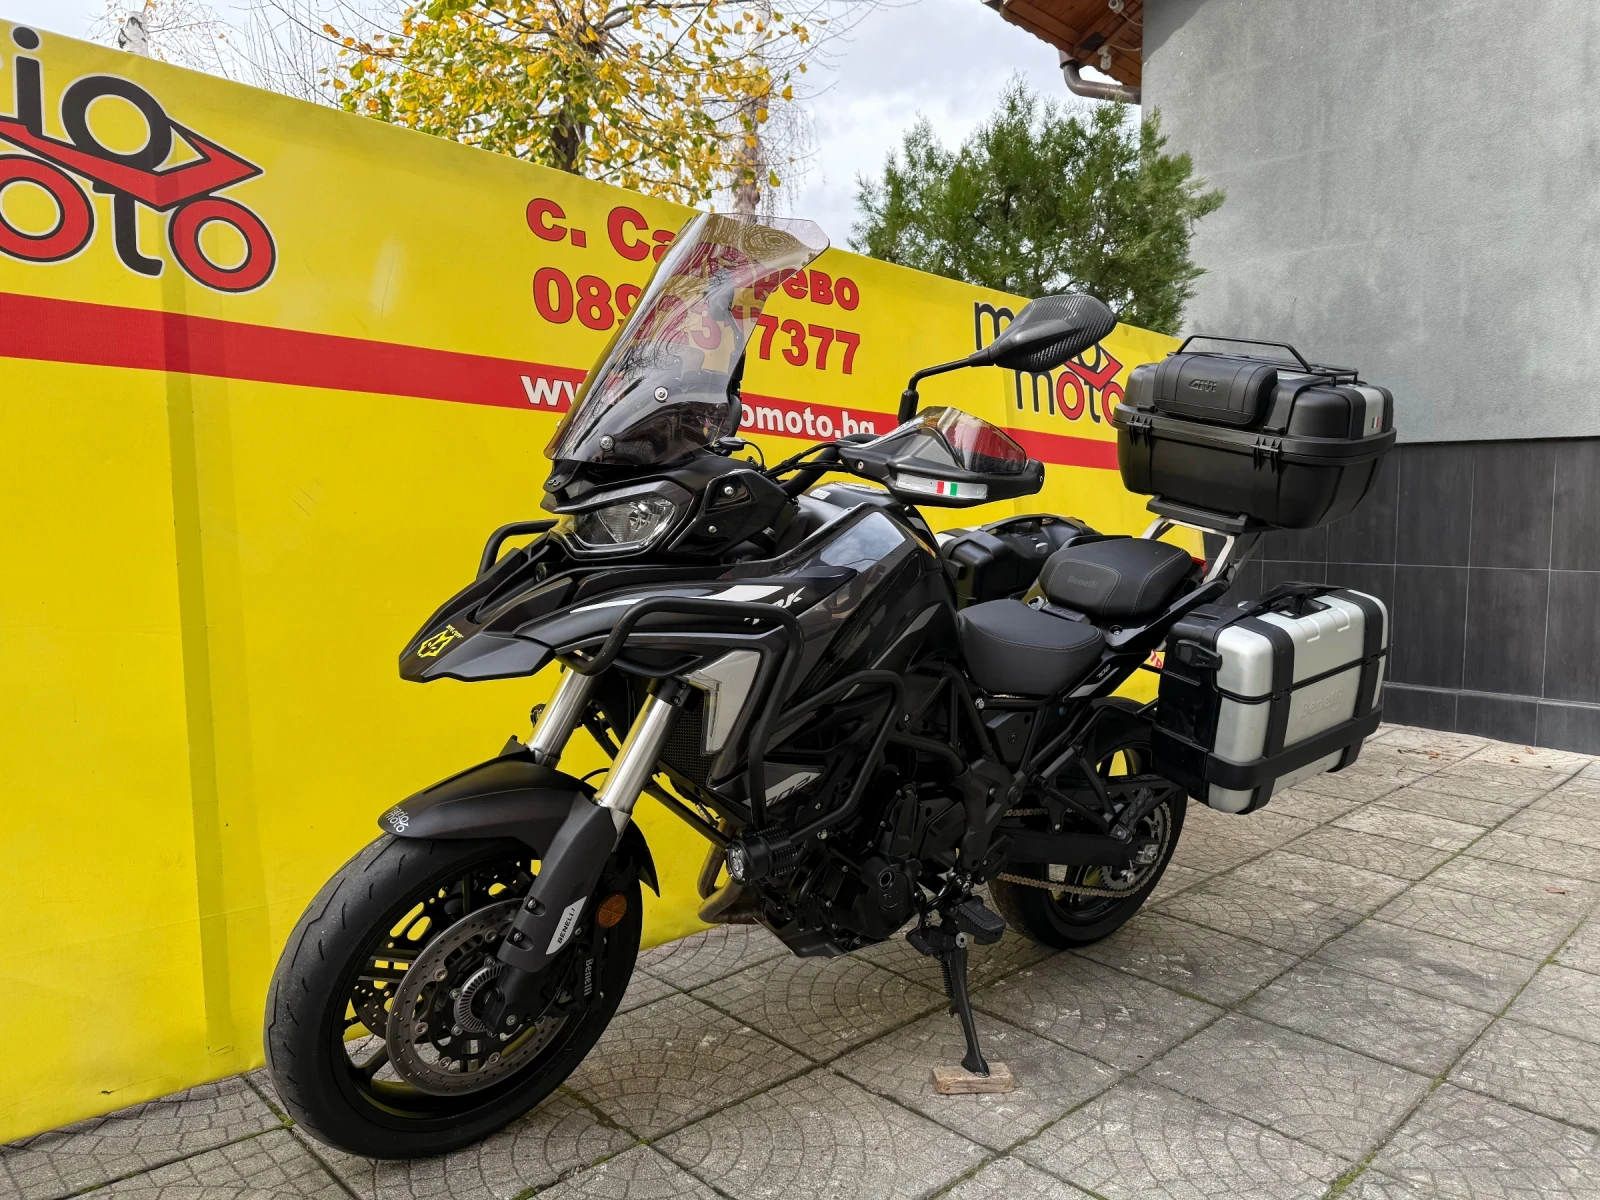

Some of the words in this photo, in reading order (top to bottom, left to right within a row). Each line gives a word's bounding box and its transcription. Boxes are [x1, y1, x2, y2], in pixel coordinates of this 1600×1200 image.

[0, 153, 276, 292] oto
[526, 198, 587, 248] с.
[1067, 574, 1099, 589] Benelli
[557, 907, 576, 944] BENELLI
[584, 958, 594, 996] Benelli
